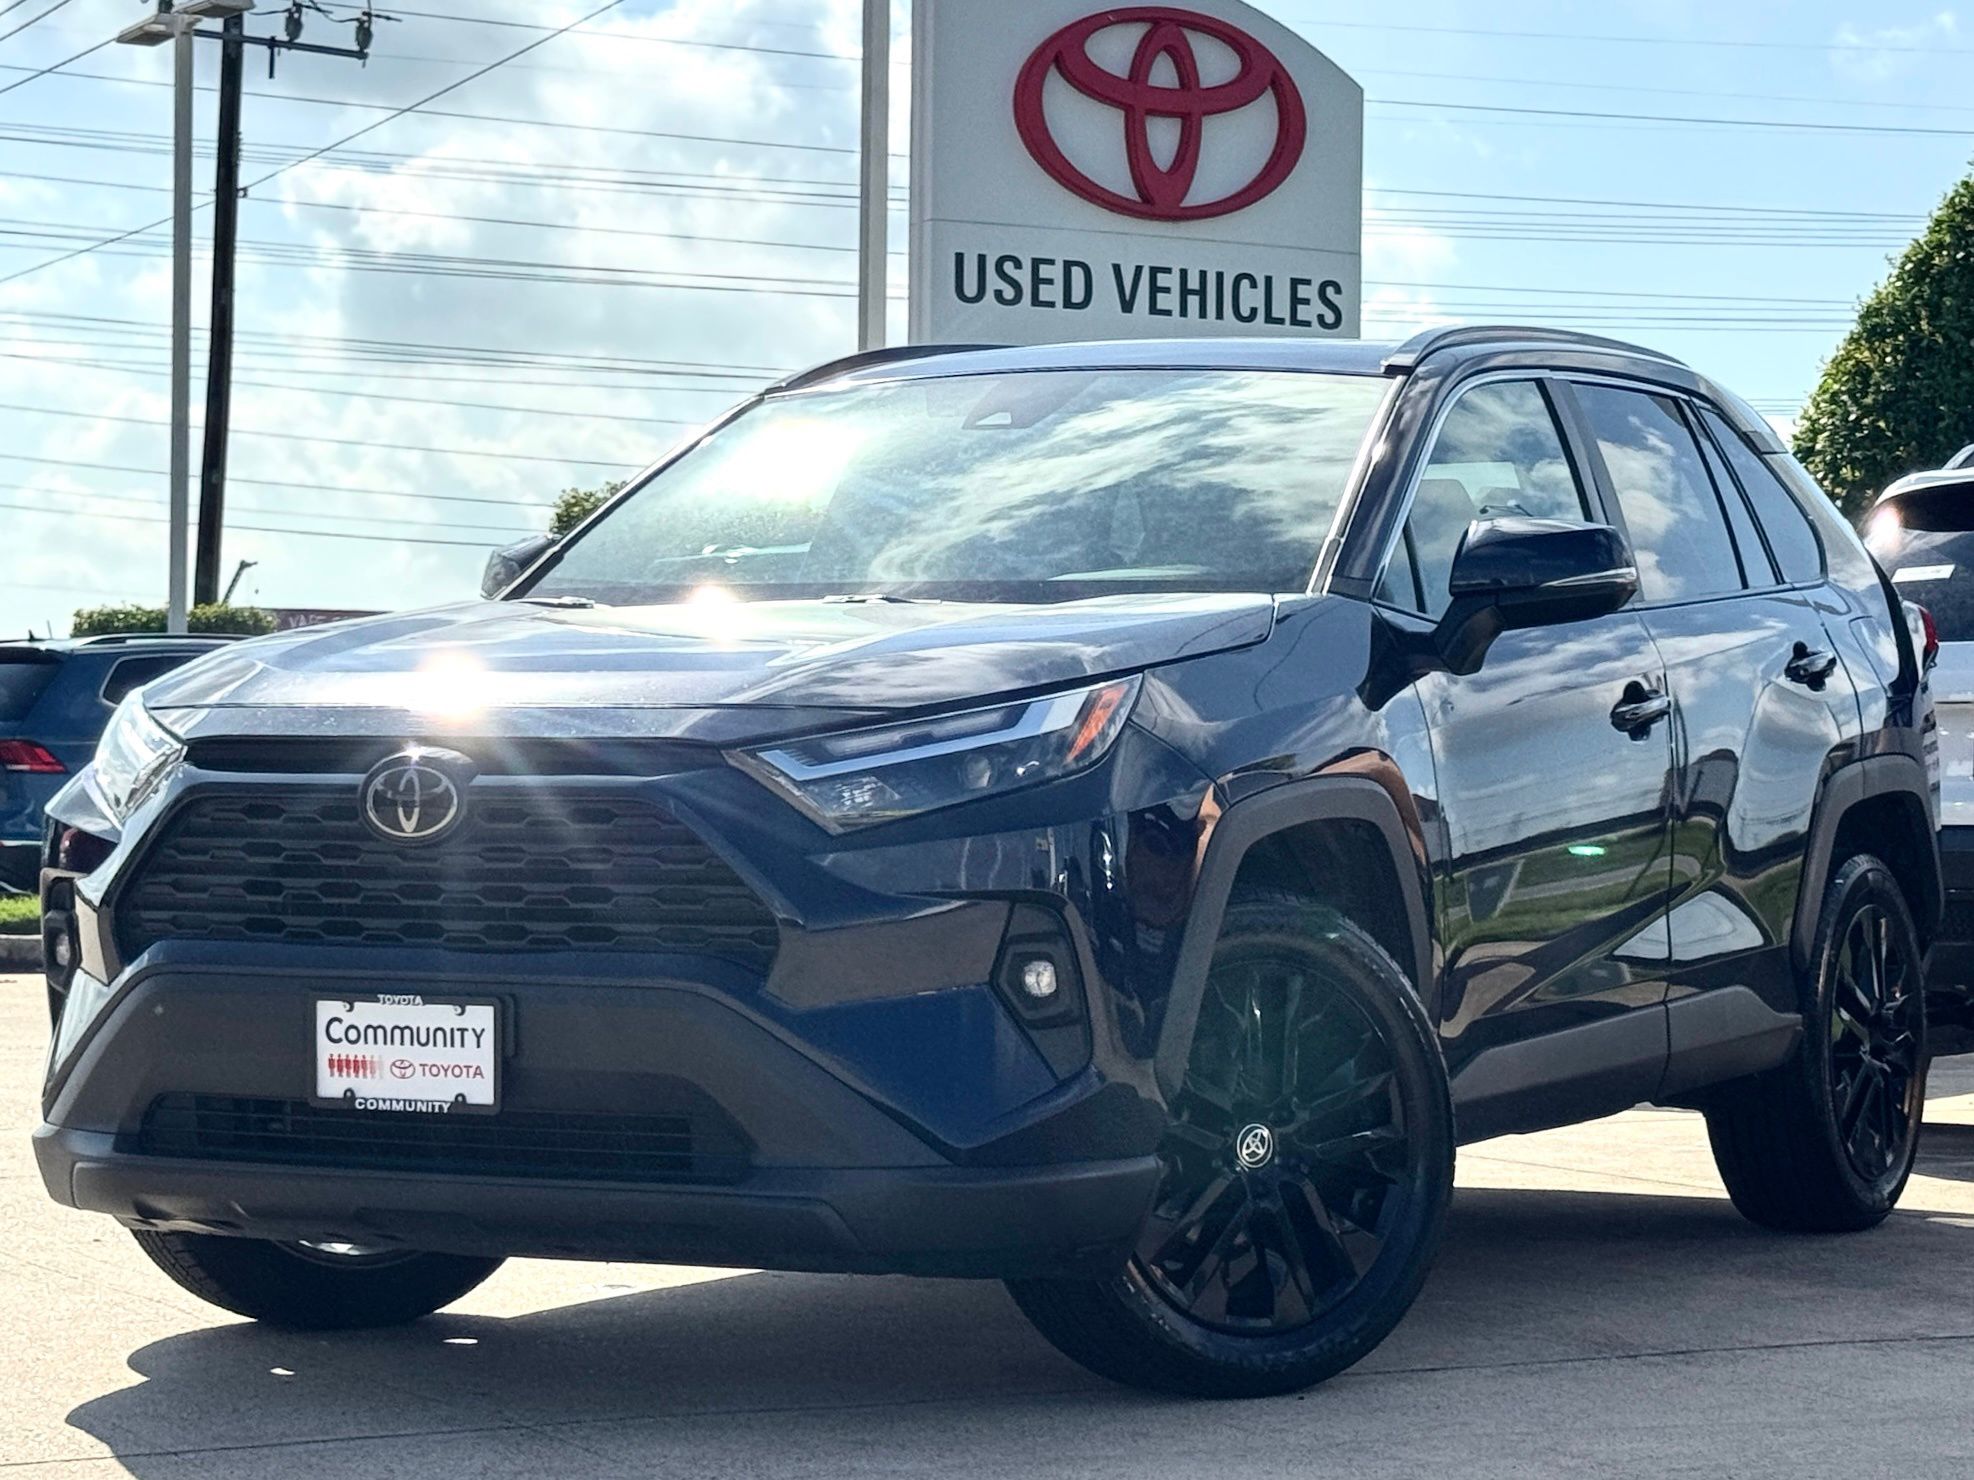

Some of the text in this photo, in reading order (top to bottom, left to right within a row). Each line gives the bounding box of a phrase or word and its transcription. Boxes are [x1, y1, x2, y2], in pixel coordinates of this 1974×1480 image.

[954, 252, 1343, 330] USED VEHICLES
[377, 994, 423, 1006] TOYOTA
[419, 1063, 485, 1079] TOYOTA
[354, 1098, 451, 1113] COMMUNITY
